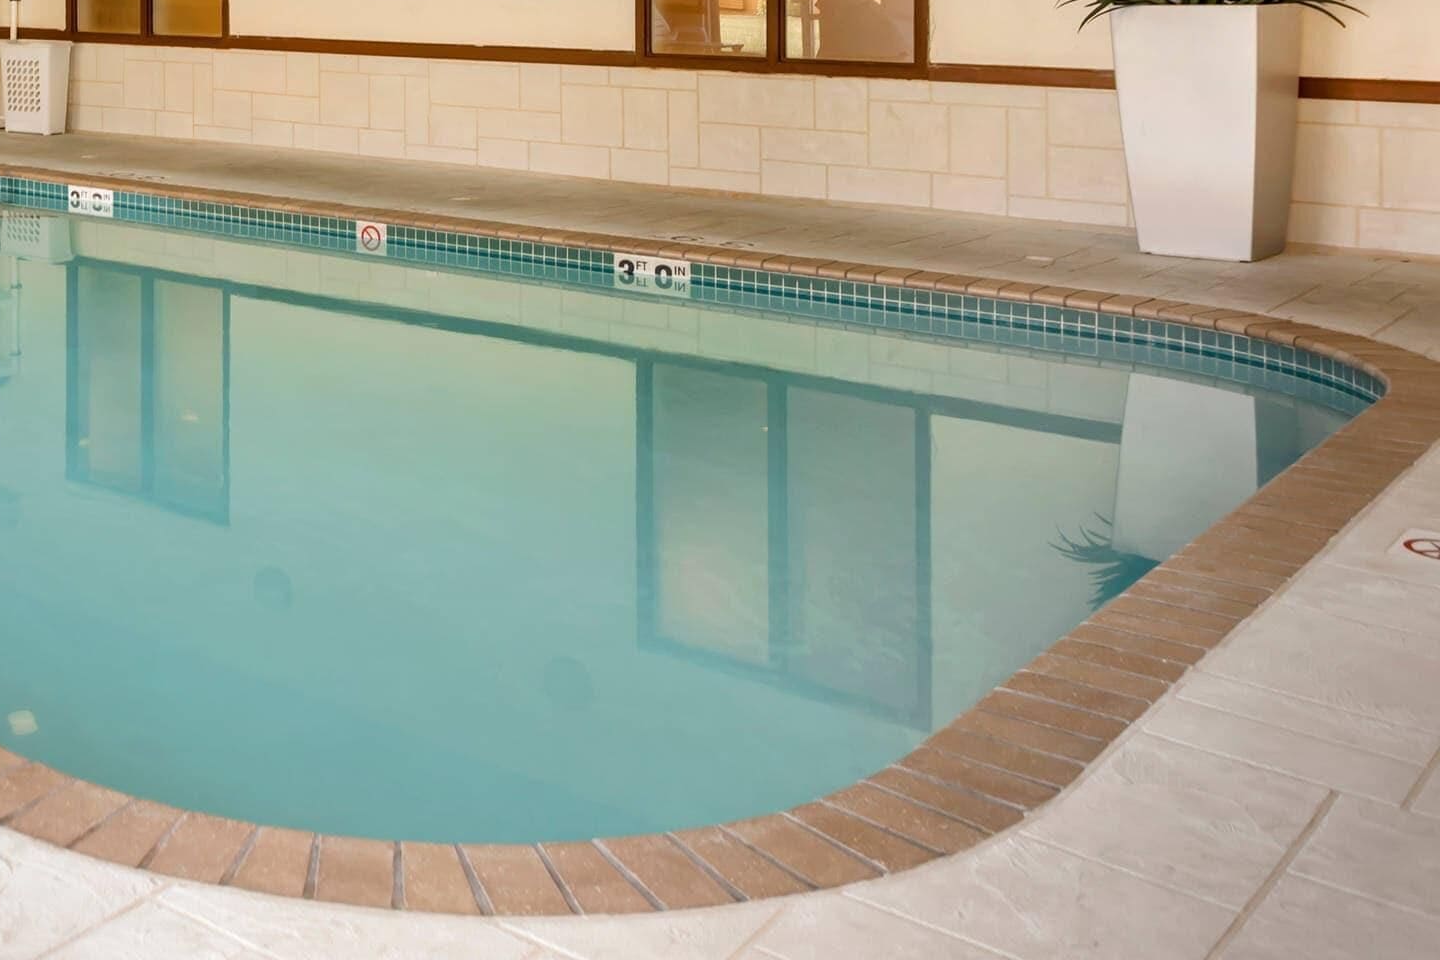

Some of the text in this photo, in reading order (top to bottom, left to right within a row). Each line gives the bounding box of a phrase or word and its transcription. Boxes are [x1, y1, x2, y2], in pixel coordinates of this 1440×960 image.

[618, 259, 635, 276] 3
[635, 260, 648, 272] FT
[673, 265, 686, 277] IN
